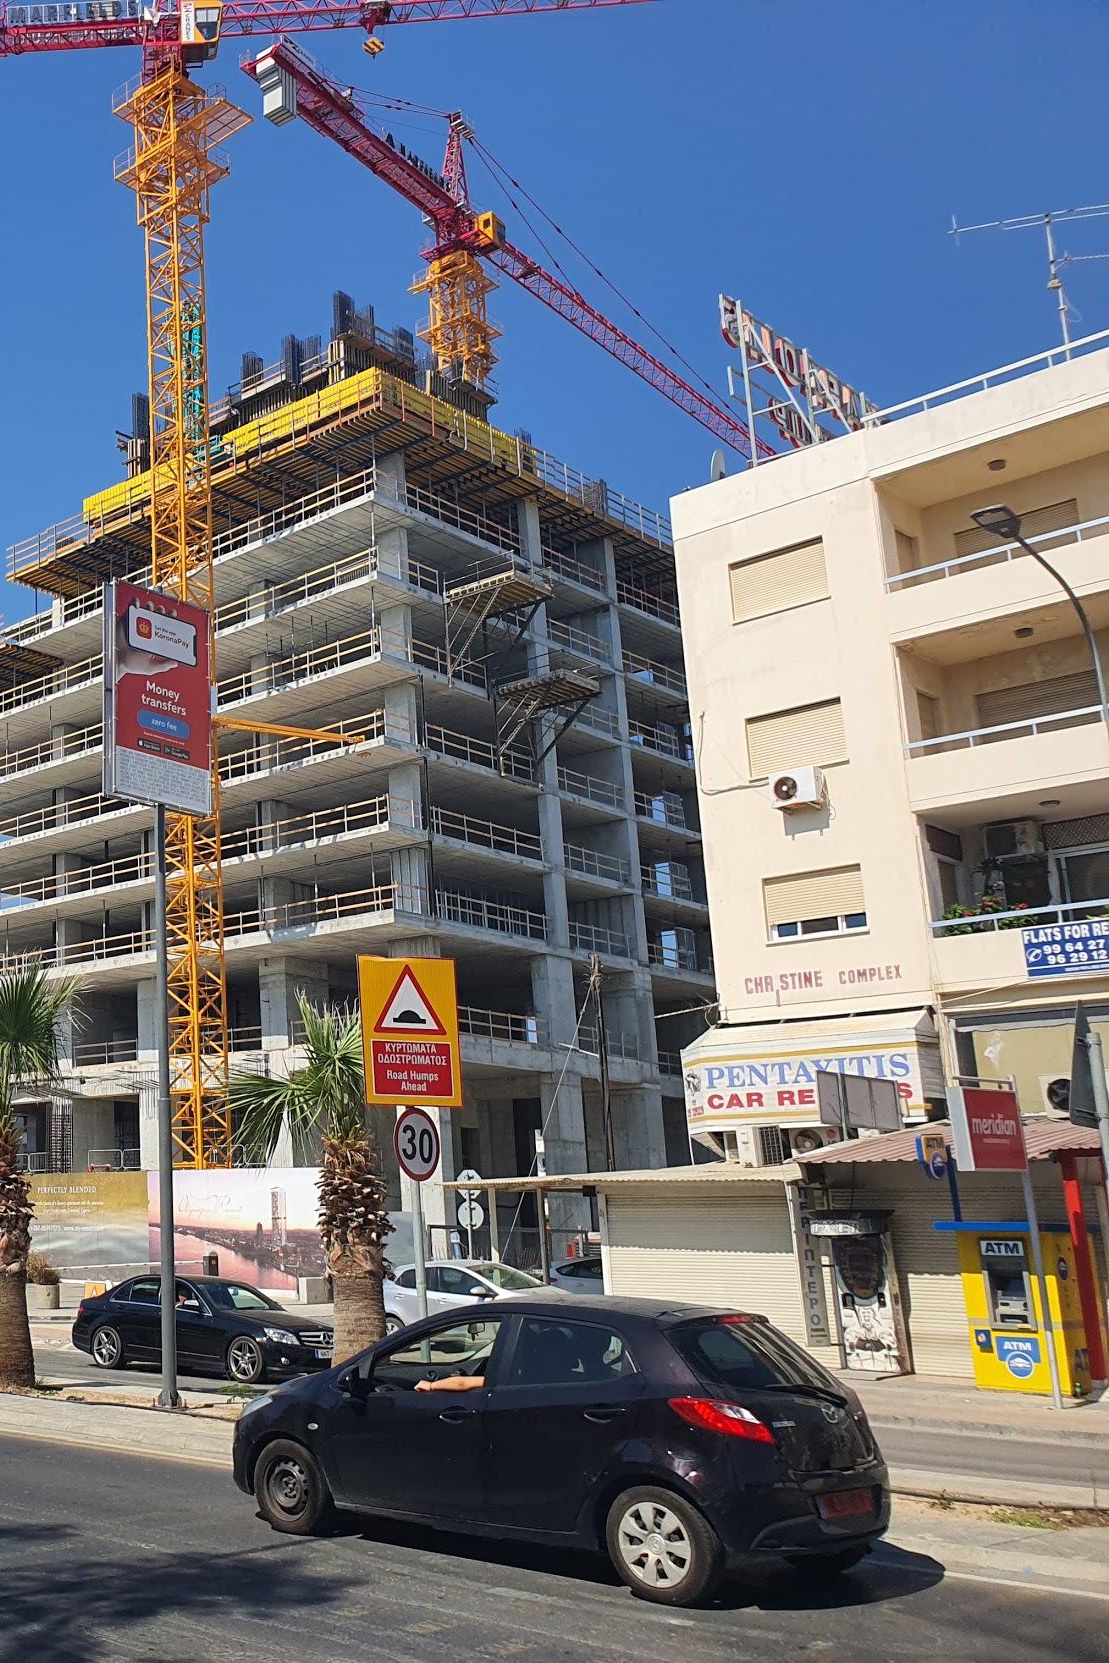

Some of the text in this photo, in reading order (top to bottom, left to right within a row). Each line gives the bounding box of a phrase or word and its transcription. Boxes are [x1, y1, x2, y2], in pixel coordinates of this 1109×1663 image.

[154, 630, 189, 649] KoronaPay
[146, 680, 180, 702] Money
[141, 693, 187, 716] transfers
[152, 718, 166, 727] zero
[1022, 927, 1062, 944] FLATS
[1064, 924, 1090, 940] FOR
[1043, 939, 1105, 955] 99 64 27
[1047, 950, 1108, 965] 96 29 12
[839, 965, 902, 984] COMPLEX
[385, 1043, 437, 1054] ΚΥΡΤΩΜΑΤΑ
[377, 1053, 447, 1066] ΟΔΟΣΤΡΩΜΑΤΟΣ
[386, 1069, 439, 1083] Road Humps
[400, 1081, 427, 1092] Ahead
[707, 1092, 764, 1110] CAR
[972, 1113, 1016, 1135] meridian
[401, 1124, 433, 1164] 30
[37, 1186, 68, 1194] PERFECTLY
[985, 1242, 1020, 1254] ATM
[1003, 1341, 1032, 1351] ATM
